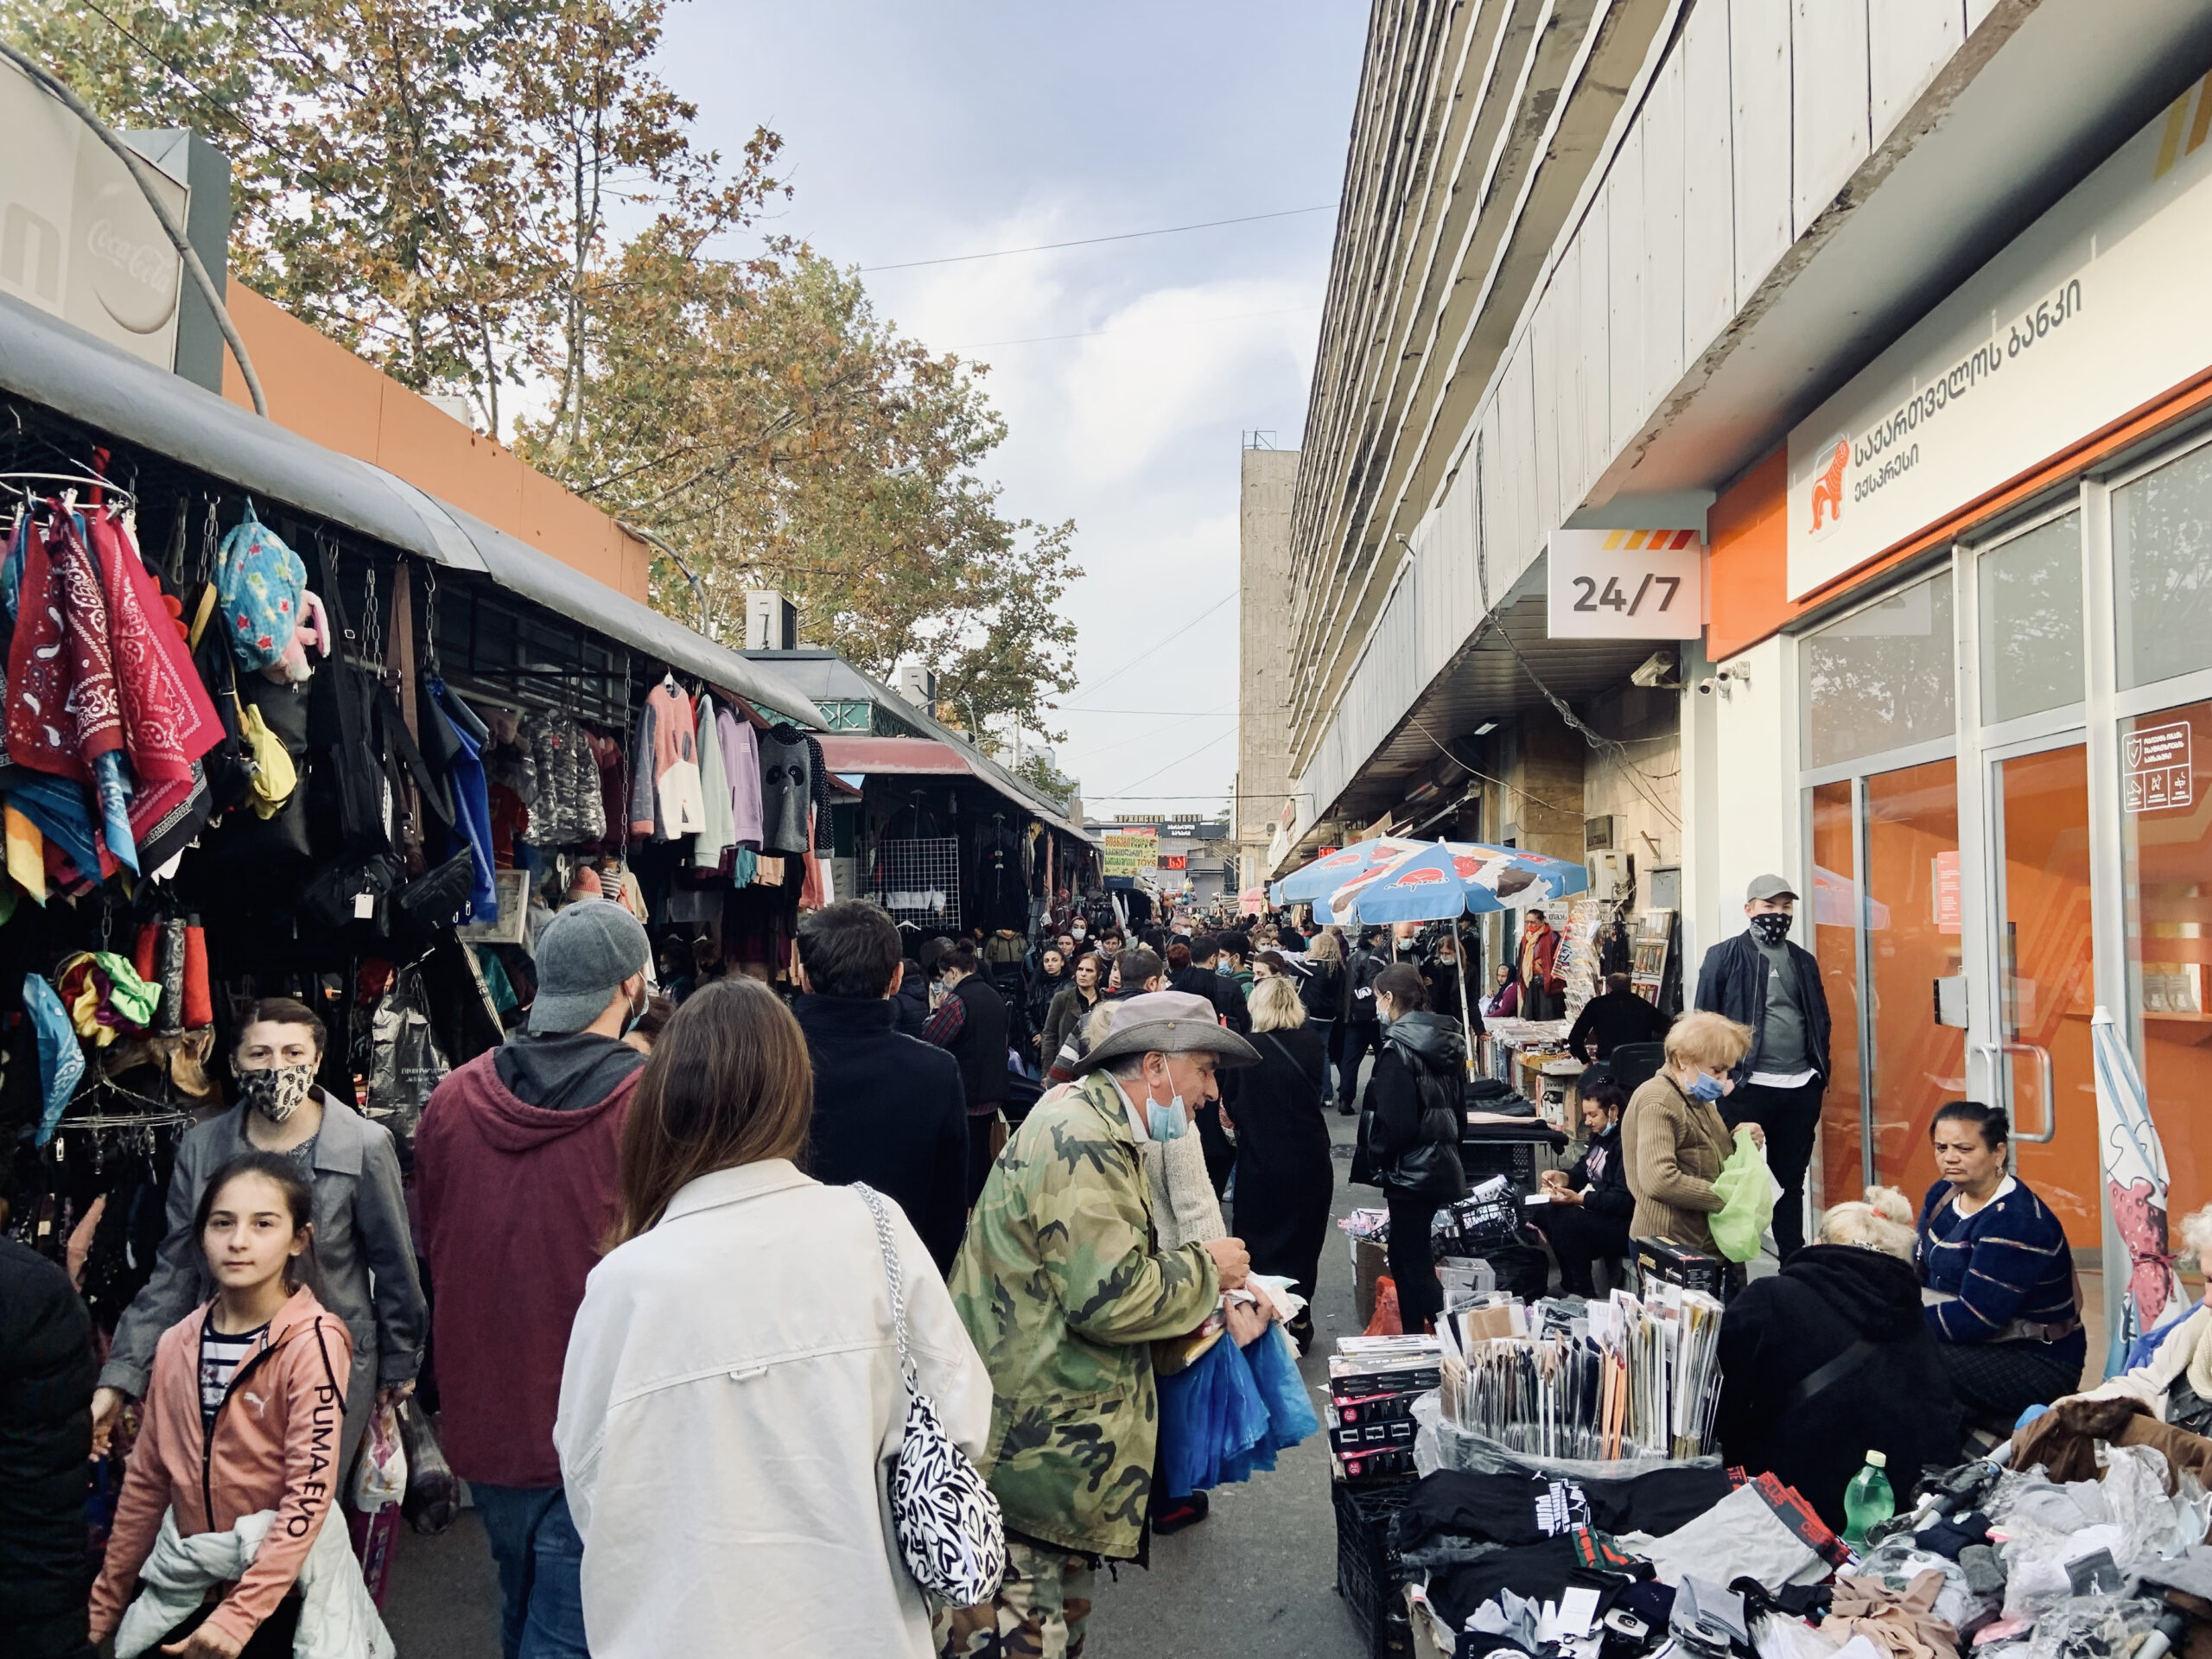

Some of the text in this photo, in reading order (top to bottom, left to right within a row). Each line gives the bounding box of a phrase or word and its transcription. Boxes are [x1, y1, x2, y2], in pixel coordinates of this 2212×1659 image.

[1854, 279, 2082, 467] საქართველოს ბანკი
[1853, 443, 1920, 503] ექსპრესი
[1572, 573, 1681, 616] 24/7
[1136, 858, 1157, 867] TOYS
